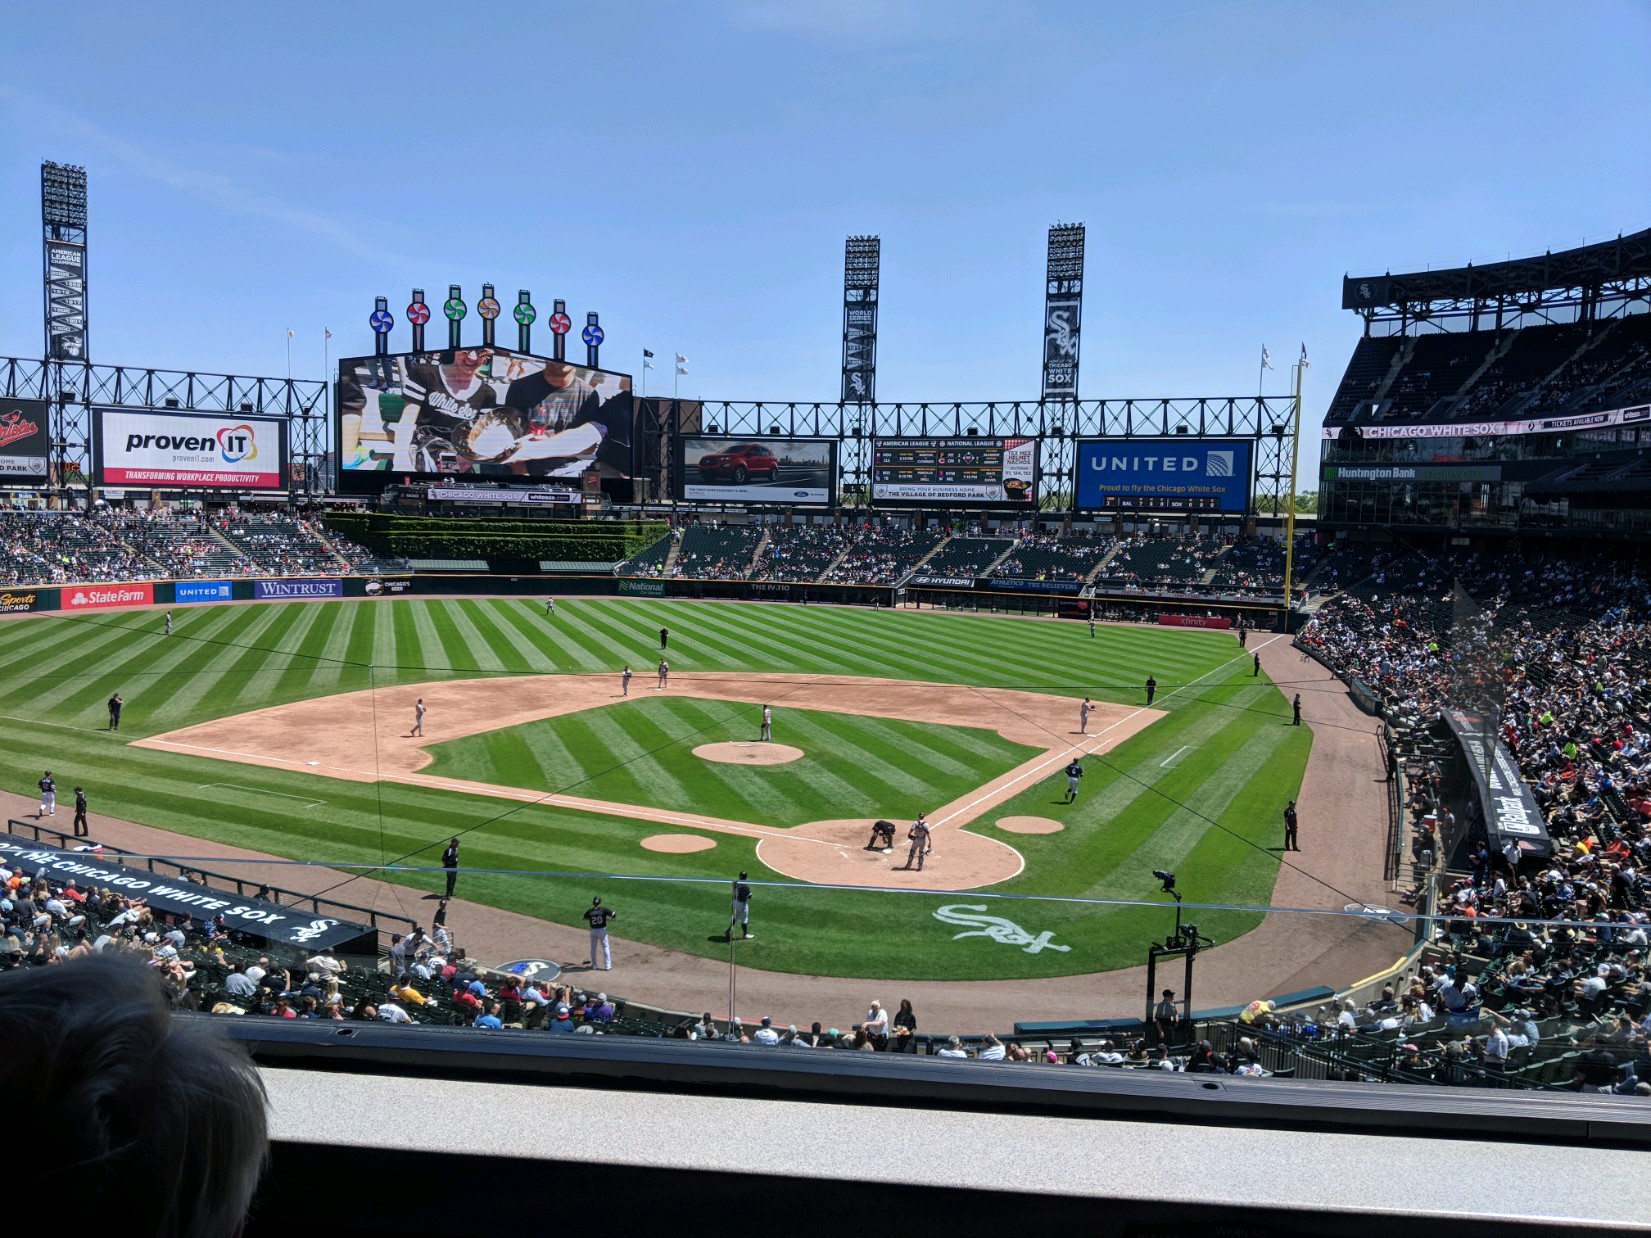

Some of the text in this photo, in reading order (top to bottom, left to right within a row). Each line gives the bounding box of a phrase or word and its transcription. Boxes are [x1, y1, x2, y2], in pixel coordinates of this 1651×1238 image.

[52, 254, 81, 262] LEAGUE
[1048, 374, 1072, 382] SOX
[428, 391, 458, 412] White
[0, 419, 38, 438] rioles
[1369, 424, 1496, 438] CHICAGO WHITE SOX
[126, 434, 215, 452] proven
[228, 436, 248, 452] IT
[1091, 457, 1198, 471] UNITED
[125, 471, 175, 480] TRANSFORMING
[176, 473, 215, 482] WORKPLACE
[1338, 467, 1416, 480] Huntington Bank
[1157, 485, 1186, 493] Chicago
[629, 582, 664, 591] National
[931, 577, 970, 586] HYUNDAI
[991, 578, 1024, 586] ATHLETICO
[261, 582, 335, 595] WINTRUST
[1, 594, 36, 606] Sports
[1180, 617, 1208, 627] xfinity
[1494, 796, 1532, 825] Ballpark
[52, 861, 151, 888] CHICAGO
[148, 885, 231, 910] WHITE
[225, 906, 287, 925] SOX
[591, 916, 602, 924] 20
